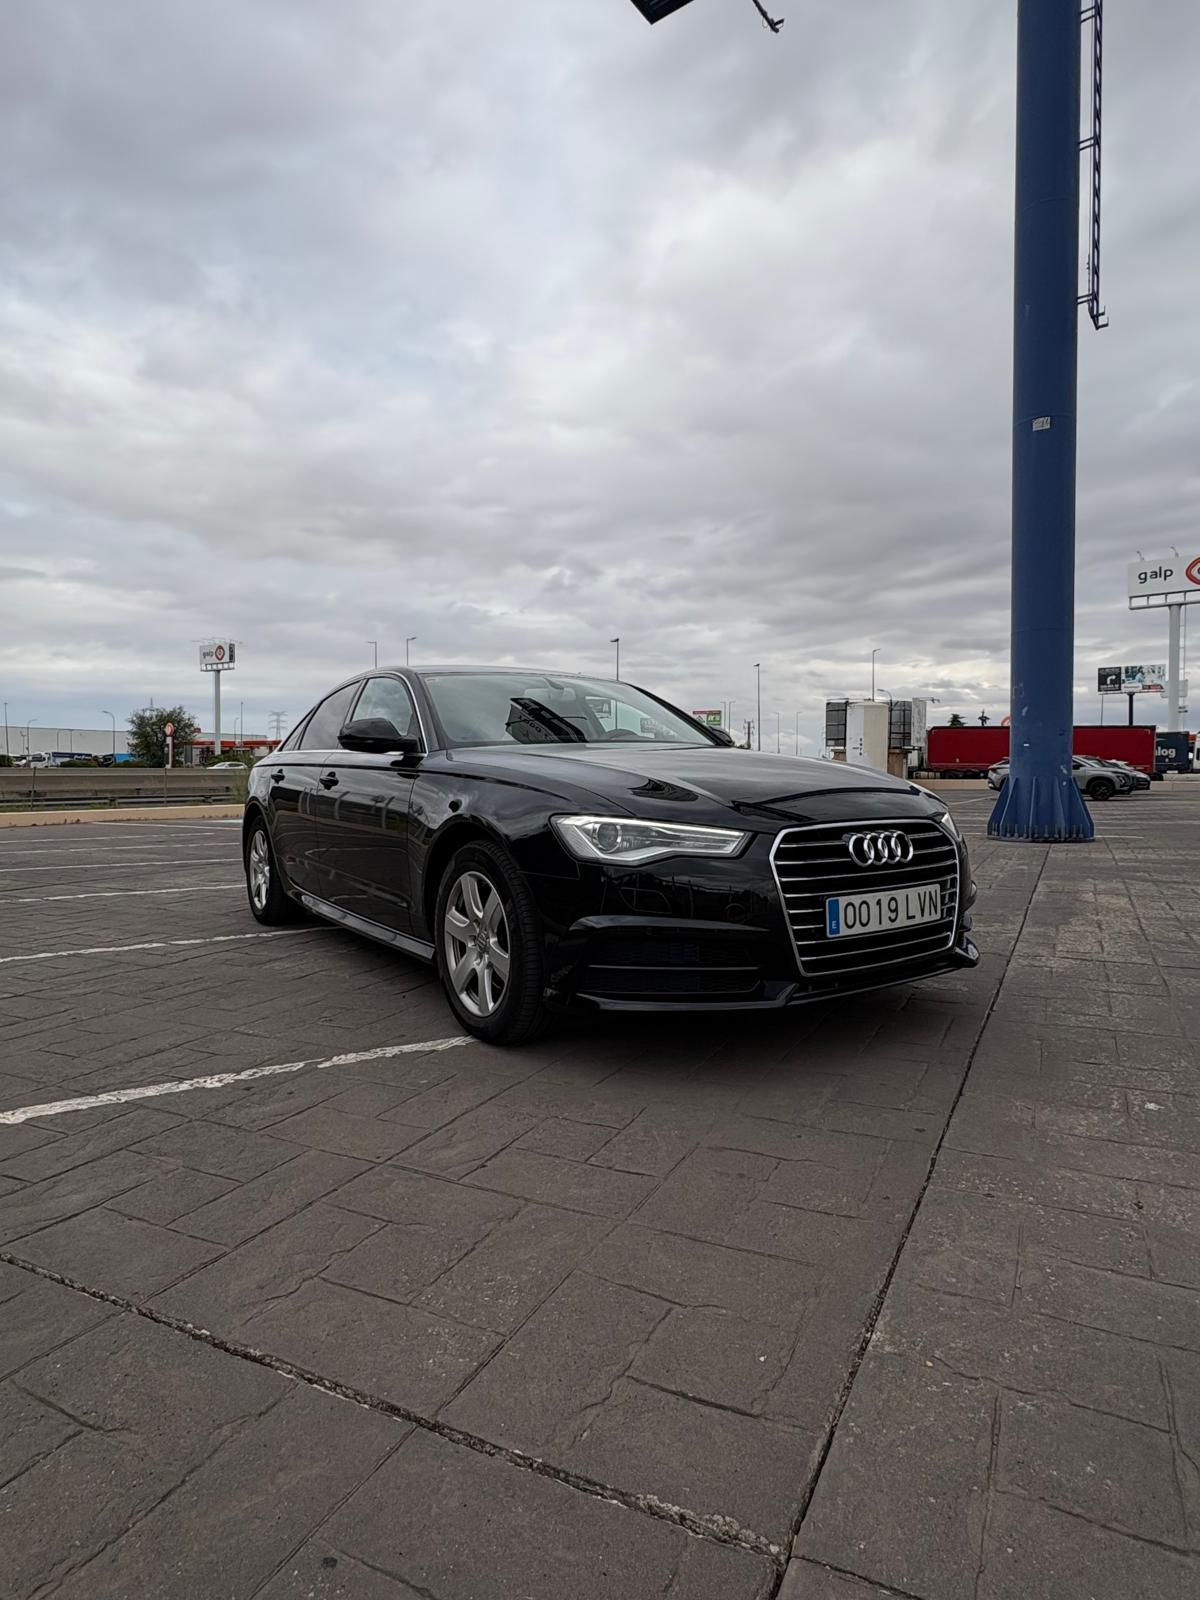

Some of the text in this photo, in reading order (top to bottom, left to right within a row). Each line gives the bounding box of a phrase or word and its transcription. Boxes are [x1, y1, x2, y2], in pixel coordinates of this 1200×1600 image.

[1137, 566, 1174, 584] galp
[1155, 746, 1176, 758] log
[843, 889, 938, 929] 0019 LVN
